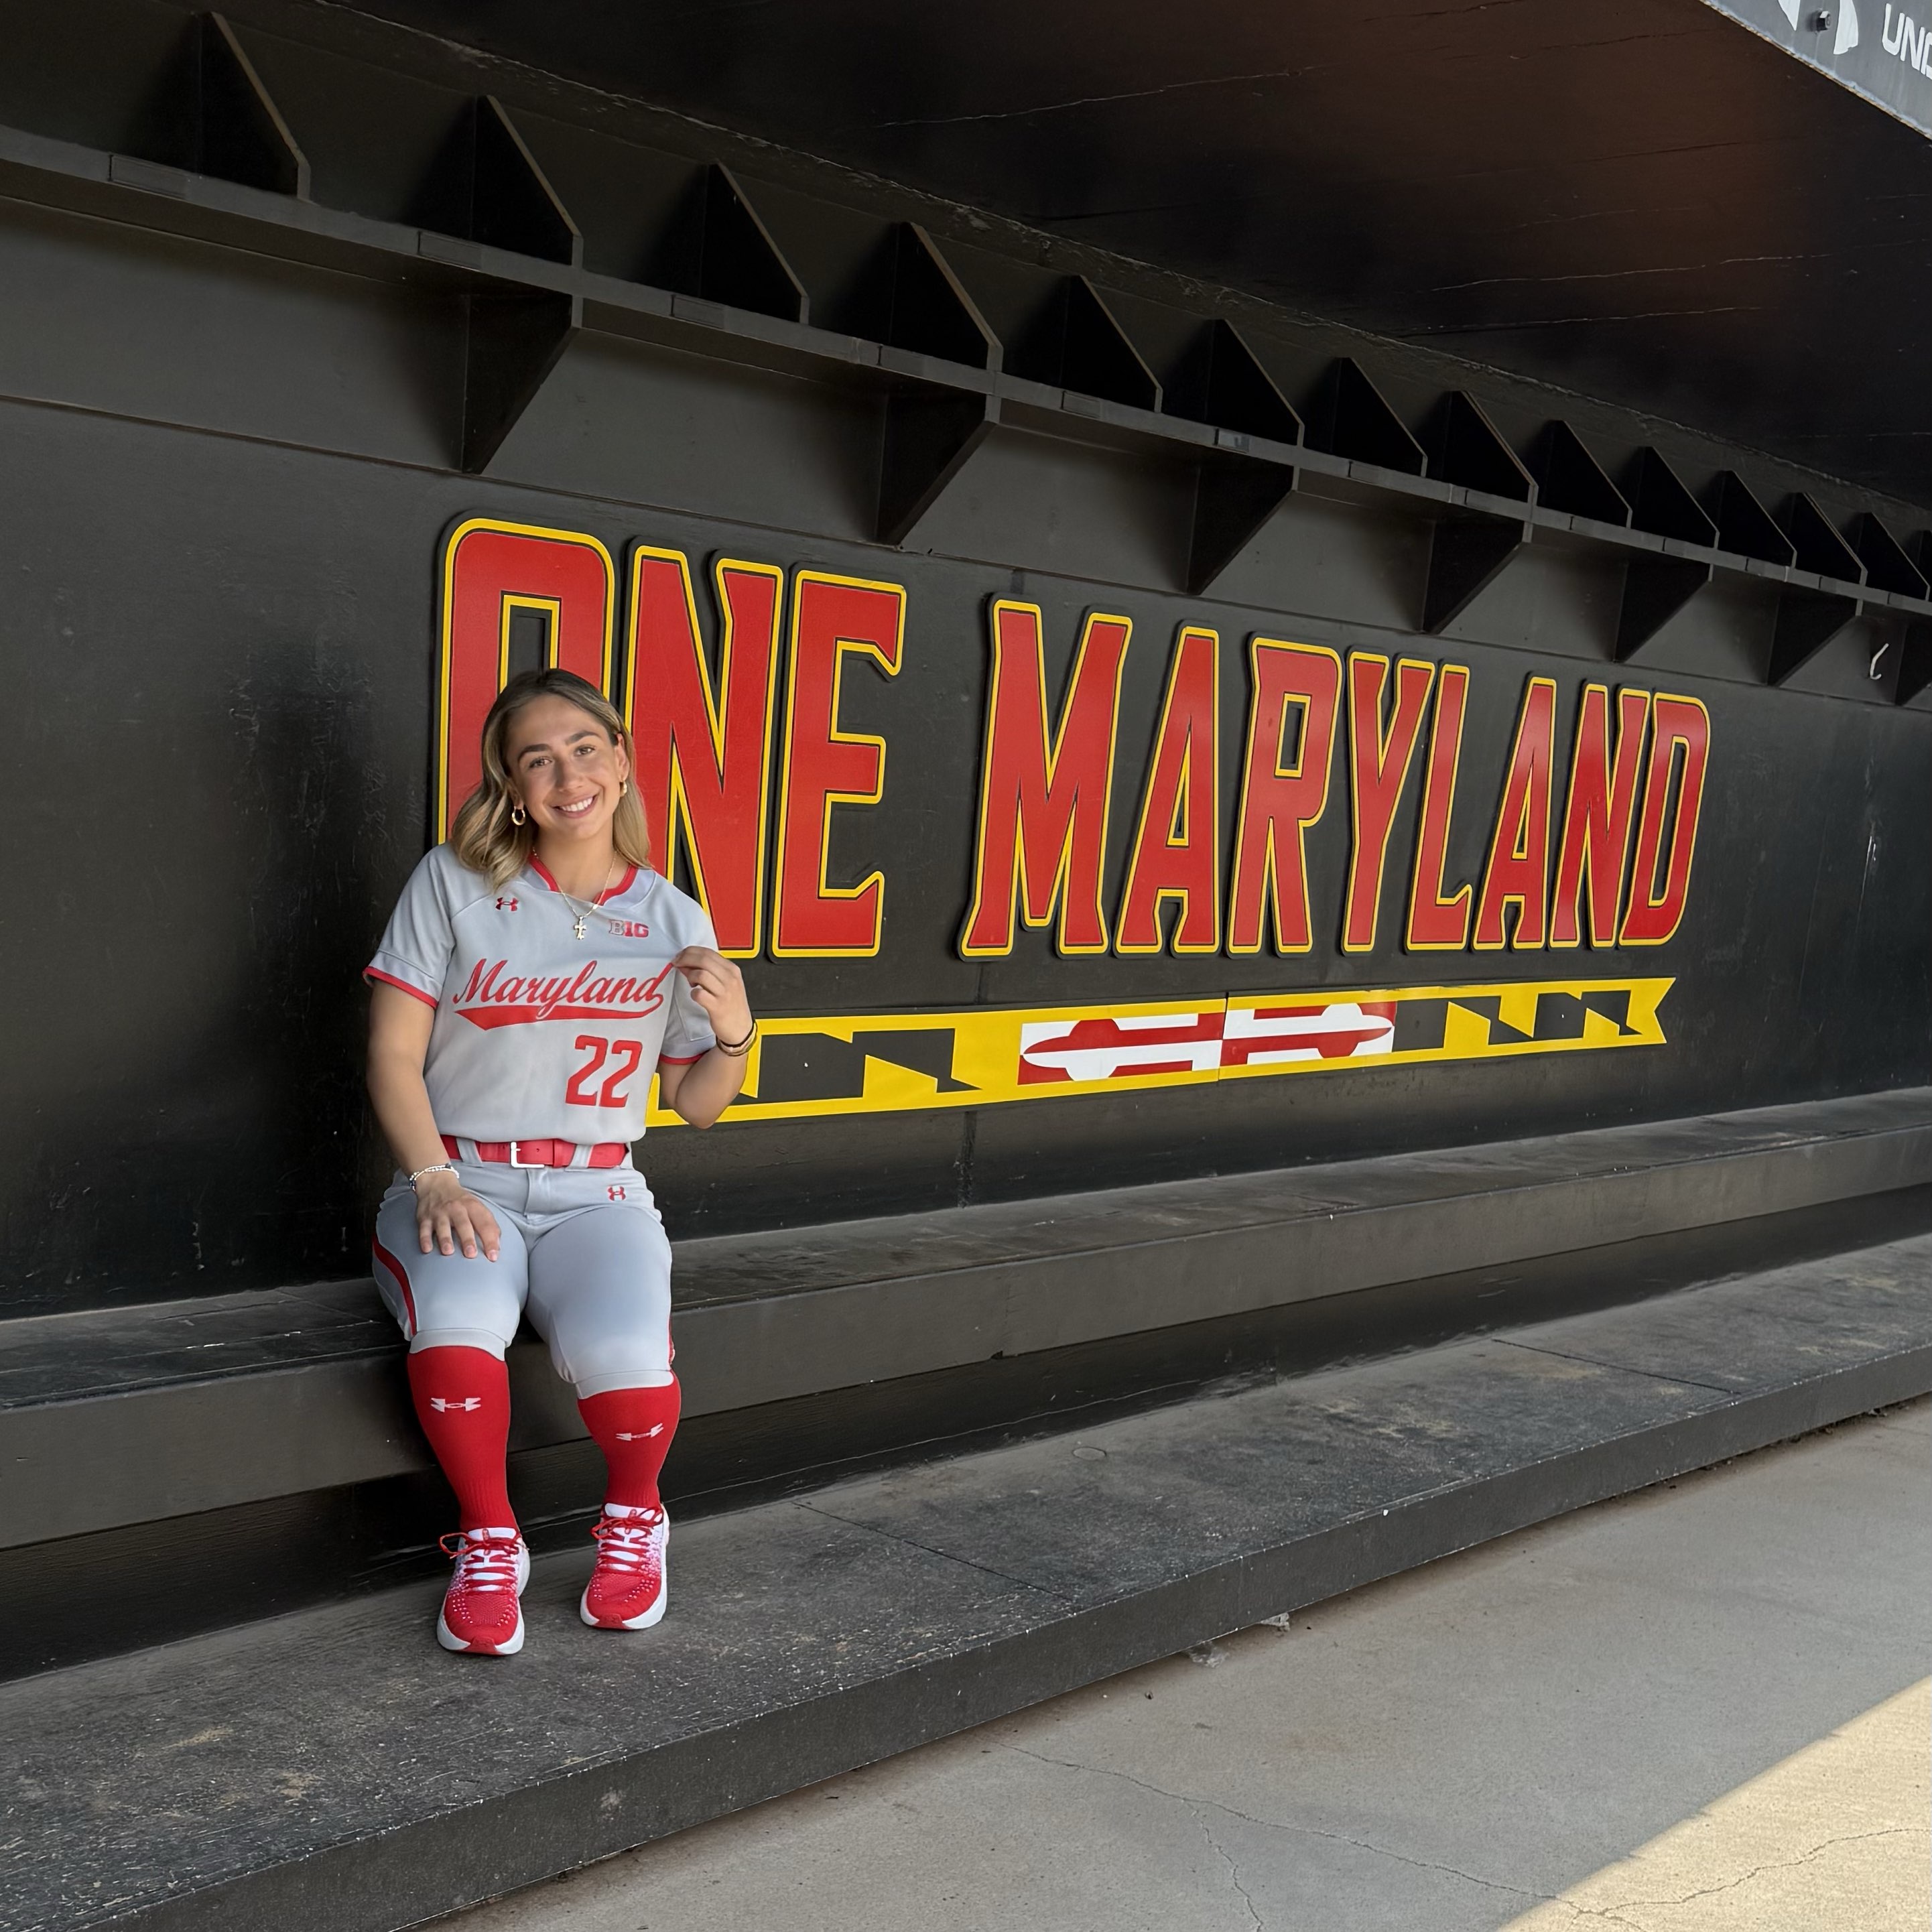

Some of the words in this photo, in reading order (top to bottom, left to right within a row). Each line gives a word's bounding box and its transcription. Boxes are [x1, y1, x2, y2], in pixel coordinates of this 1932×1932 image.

[438, 518, 907, 958] ONE
[960, 598, 1712, 955] MARYLAND
[452, 958, 673, 1020] Maryland
[565, 1034, 643, 1108] 22
